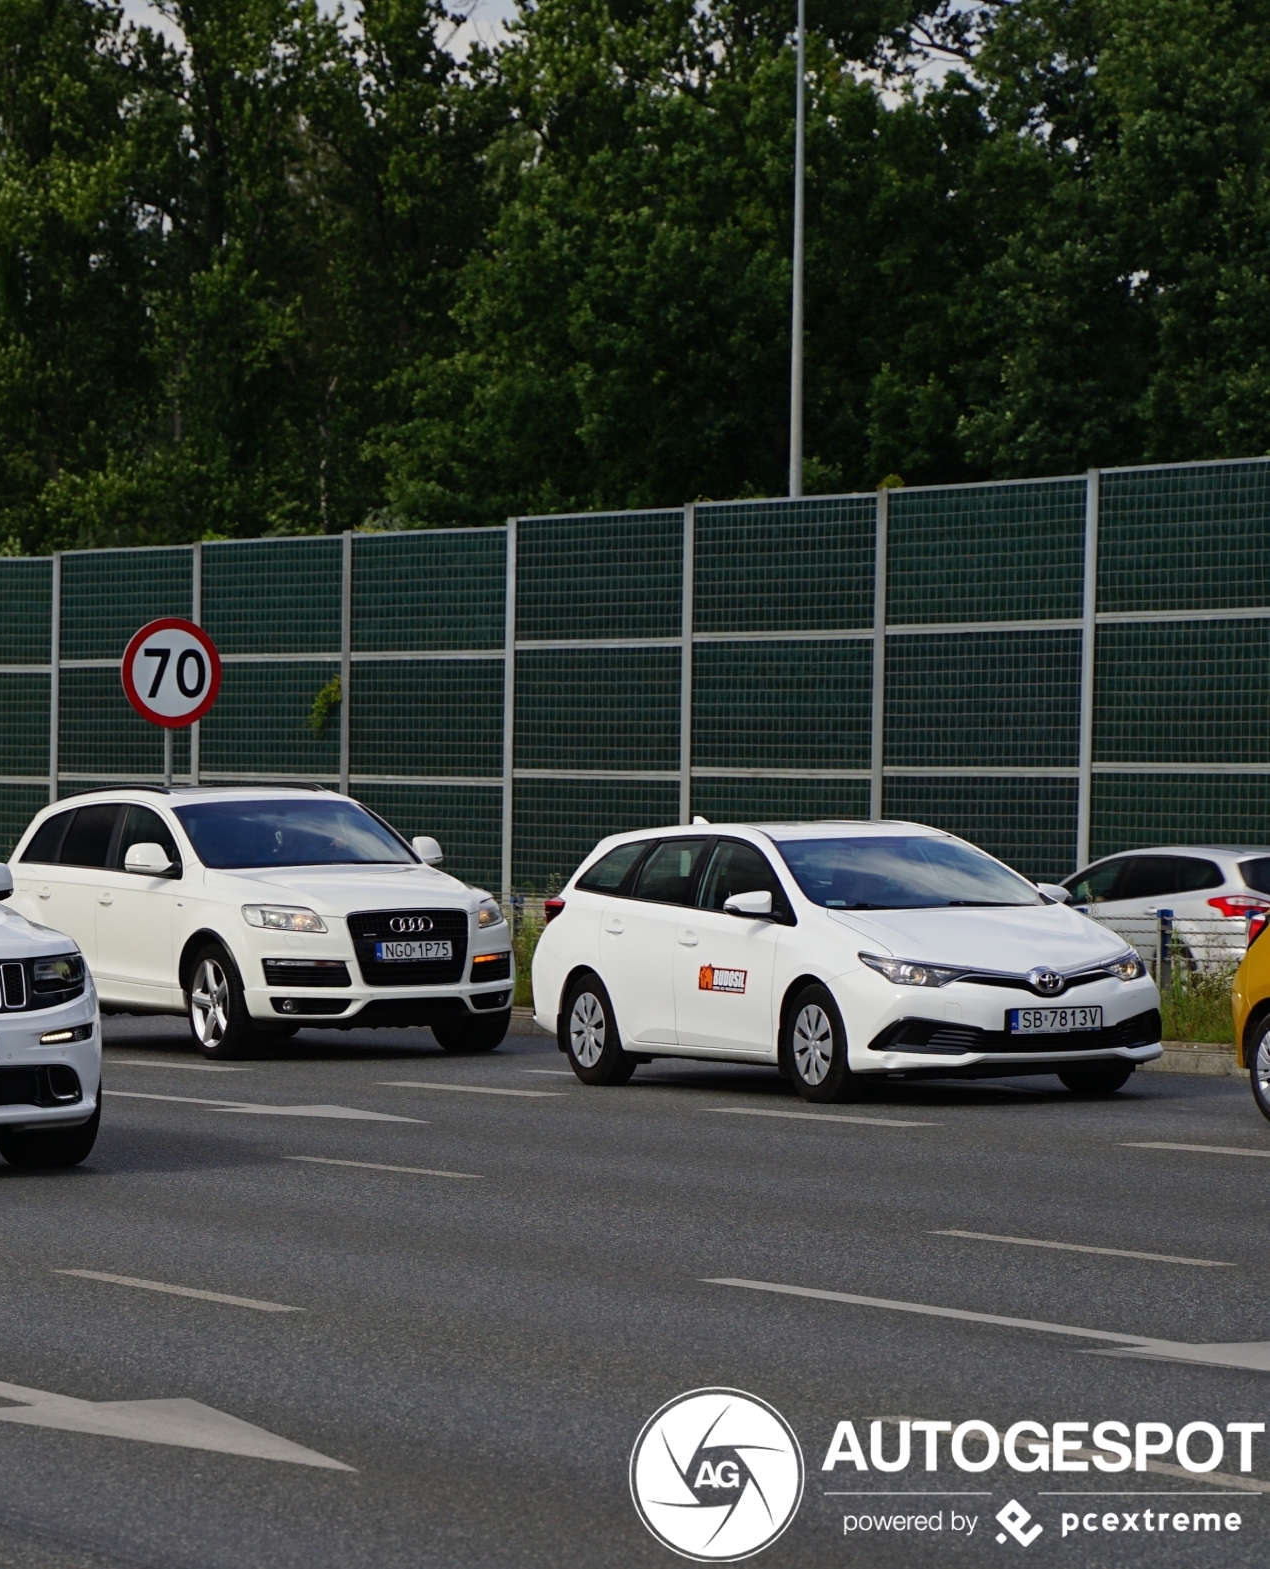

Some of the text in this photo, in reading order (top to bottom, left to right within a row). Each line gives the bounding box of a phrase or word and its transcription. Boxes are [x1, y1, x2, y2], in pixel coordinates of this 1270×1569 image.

[144, 648, 205, 698] 70
[385, 942, 449, 958] NGO 1P75
[713, 969, 745, 988] BUDOSIL
[1022, 1009, 1098, 1028] SB 7813V
